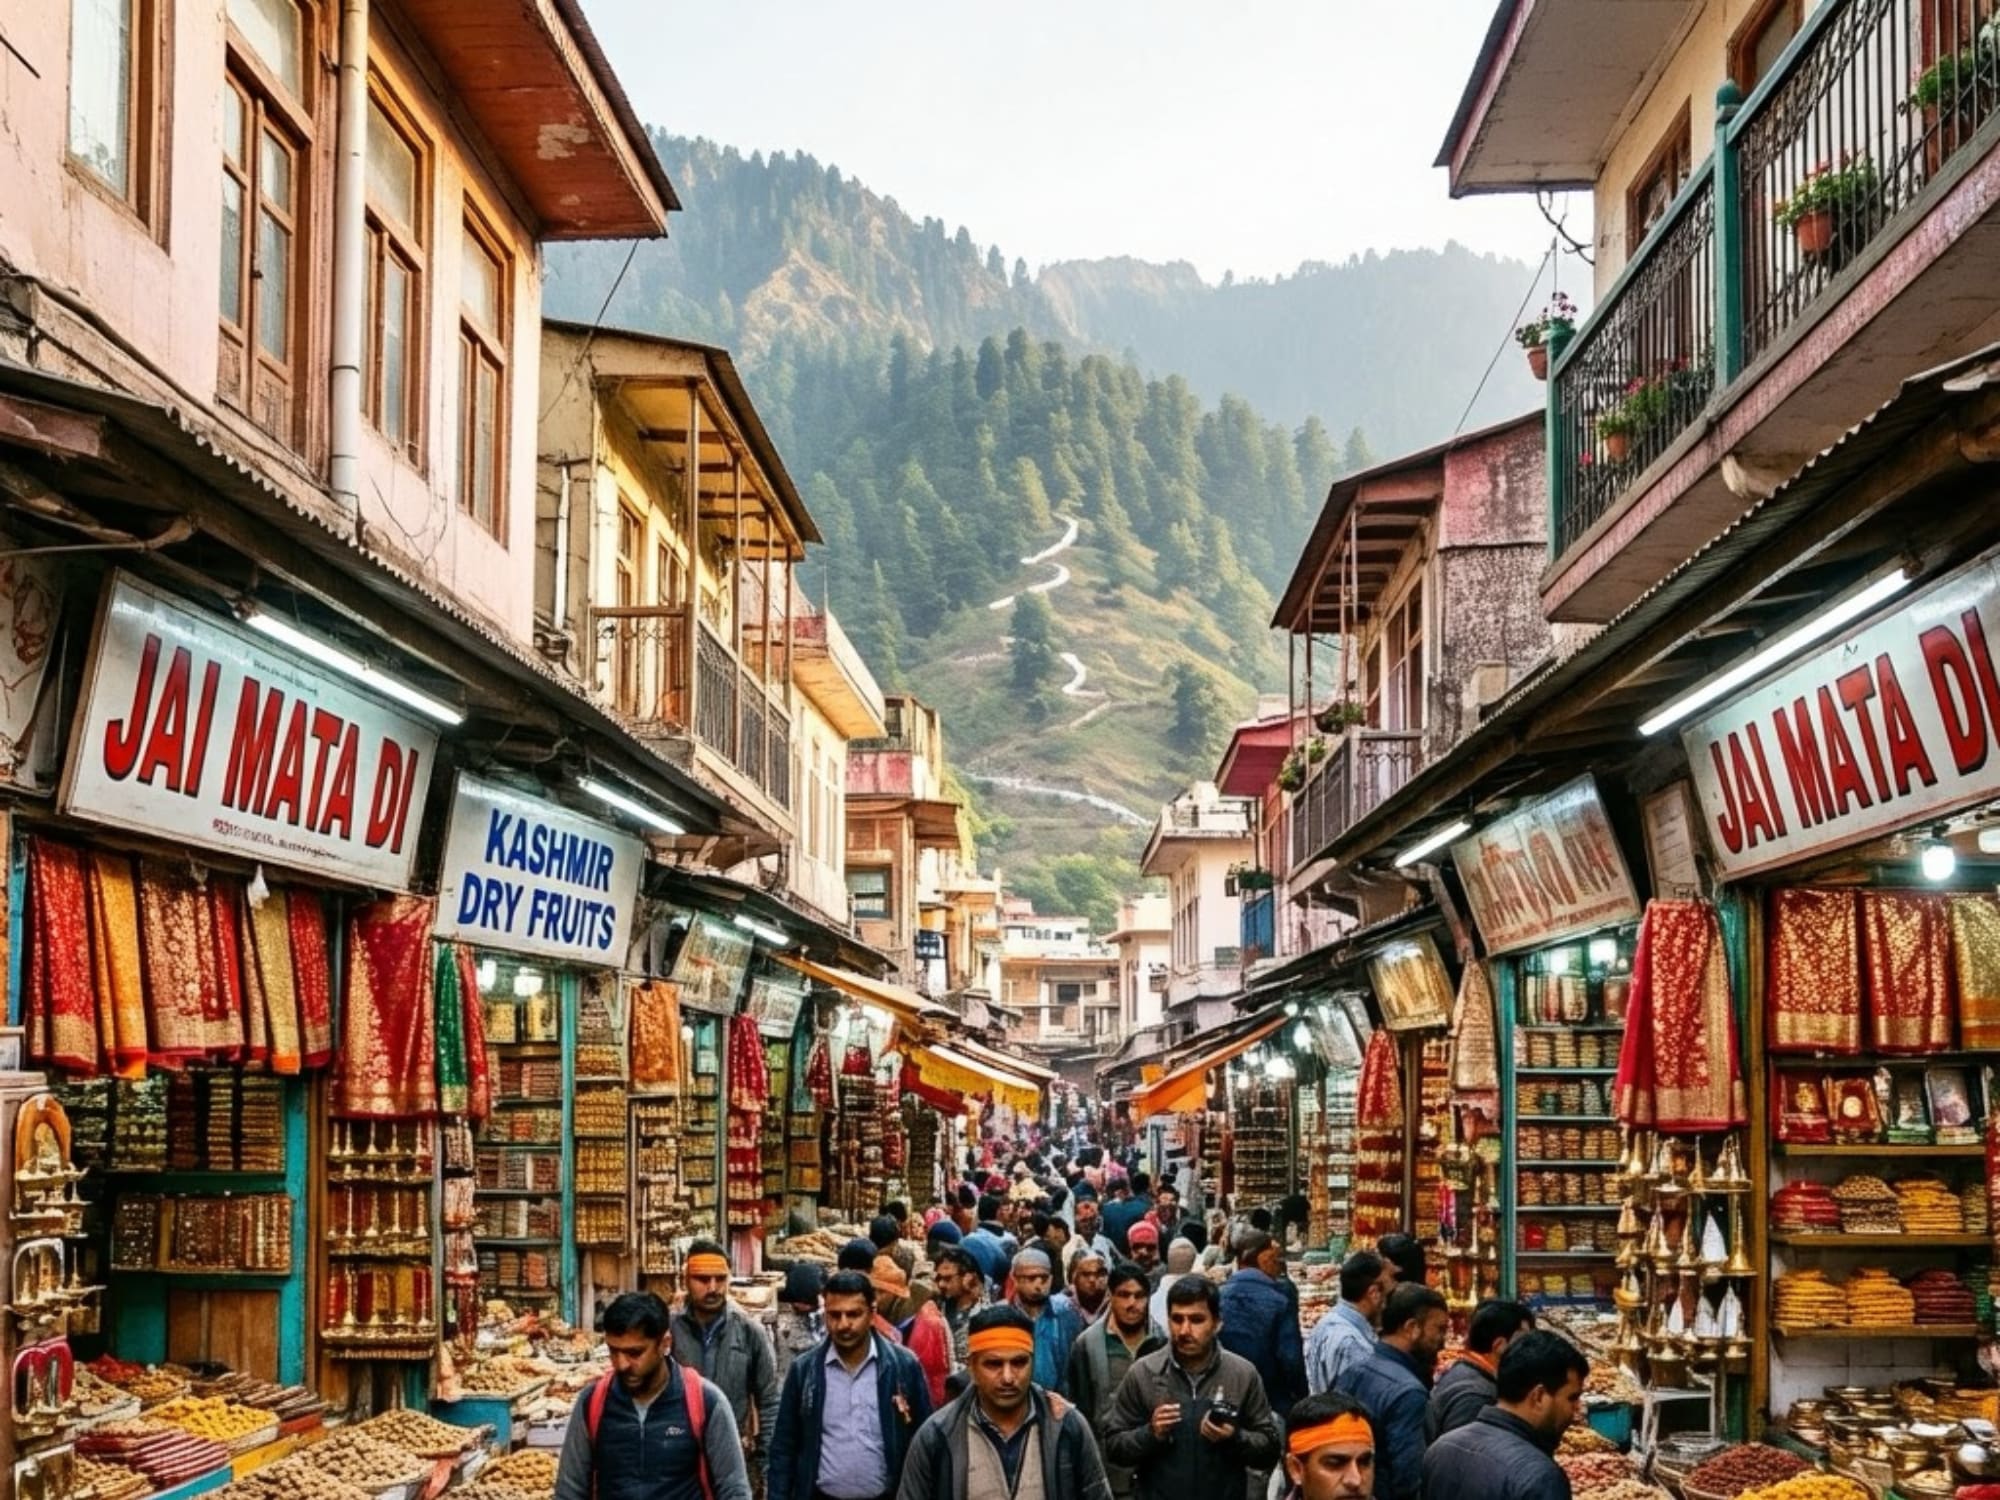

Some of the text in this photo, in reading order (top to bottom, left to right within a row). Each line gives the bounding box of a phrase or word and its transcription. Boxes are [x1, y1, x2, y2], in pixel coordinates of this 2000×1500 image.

[105, 633, 418, 854] JAI MATA DI
[1709, 722, 1787, 854] JAI
[1773, 653, 1937, 828] MATA
[1919, 607, 2000, 777] DI
[458, 872, 615, 950] DRY FRUITS
[485, 809, 613, 891] KASHMIR
